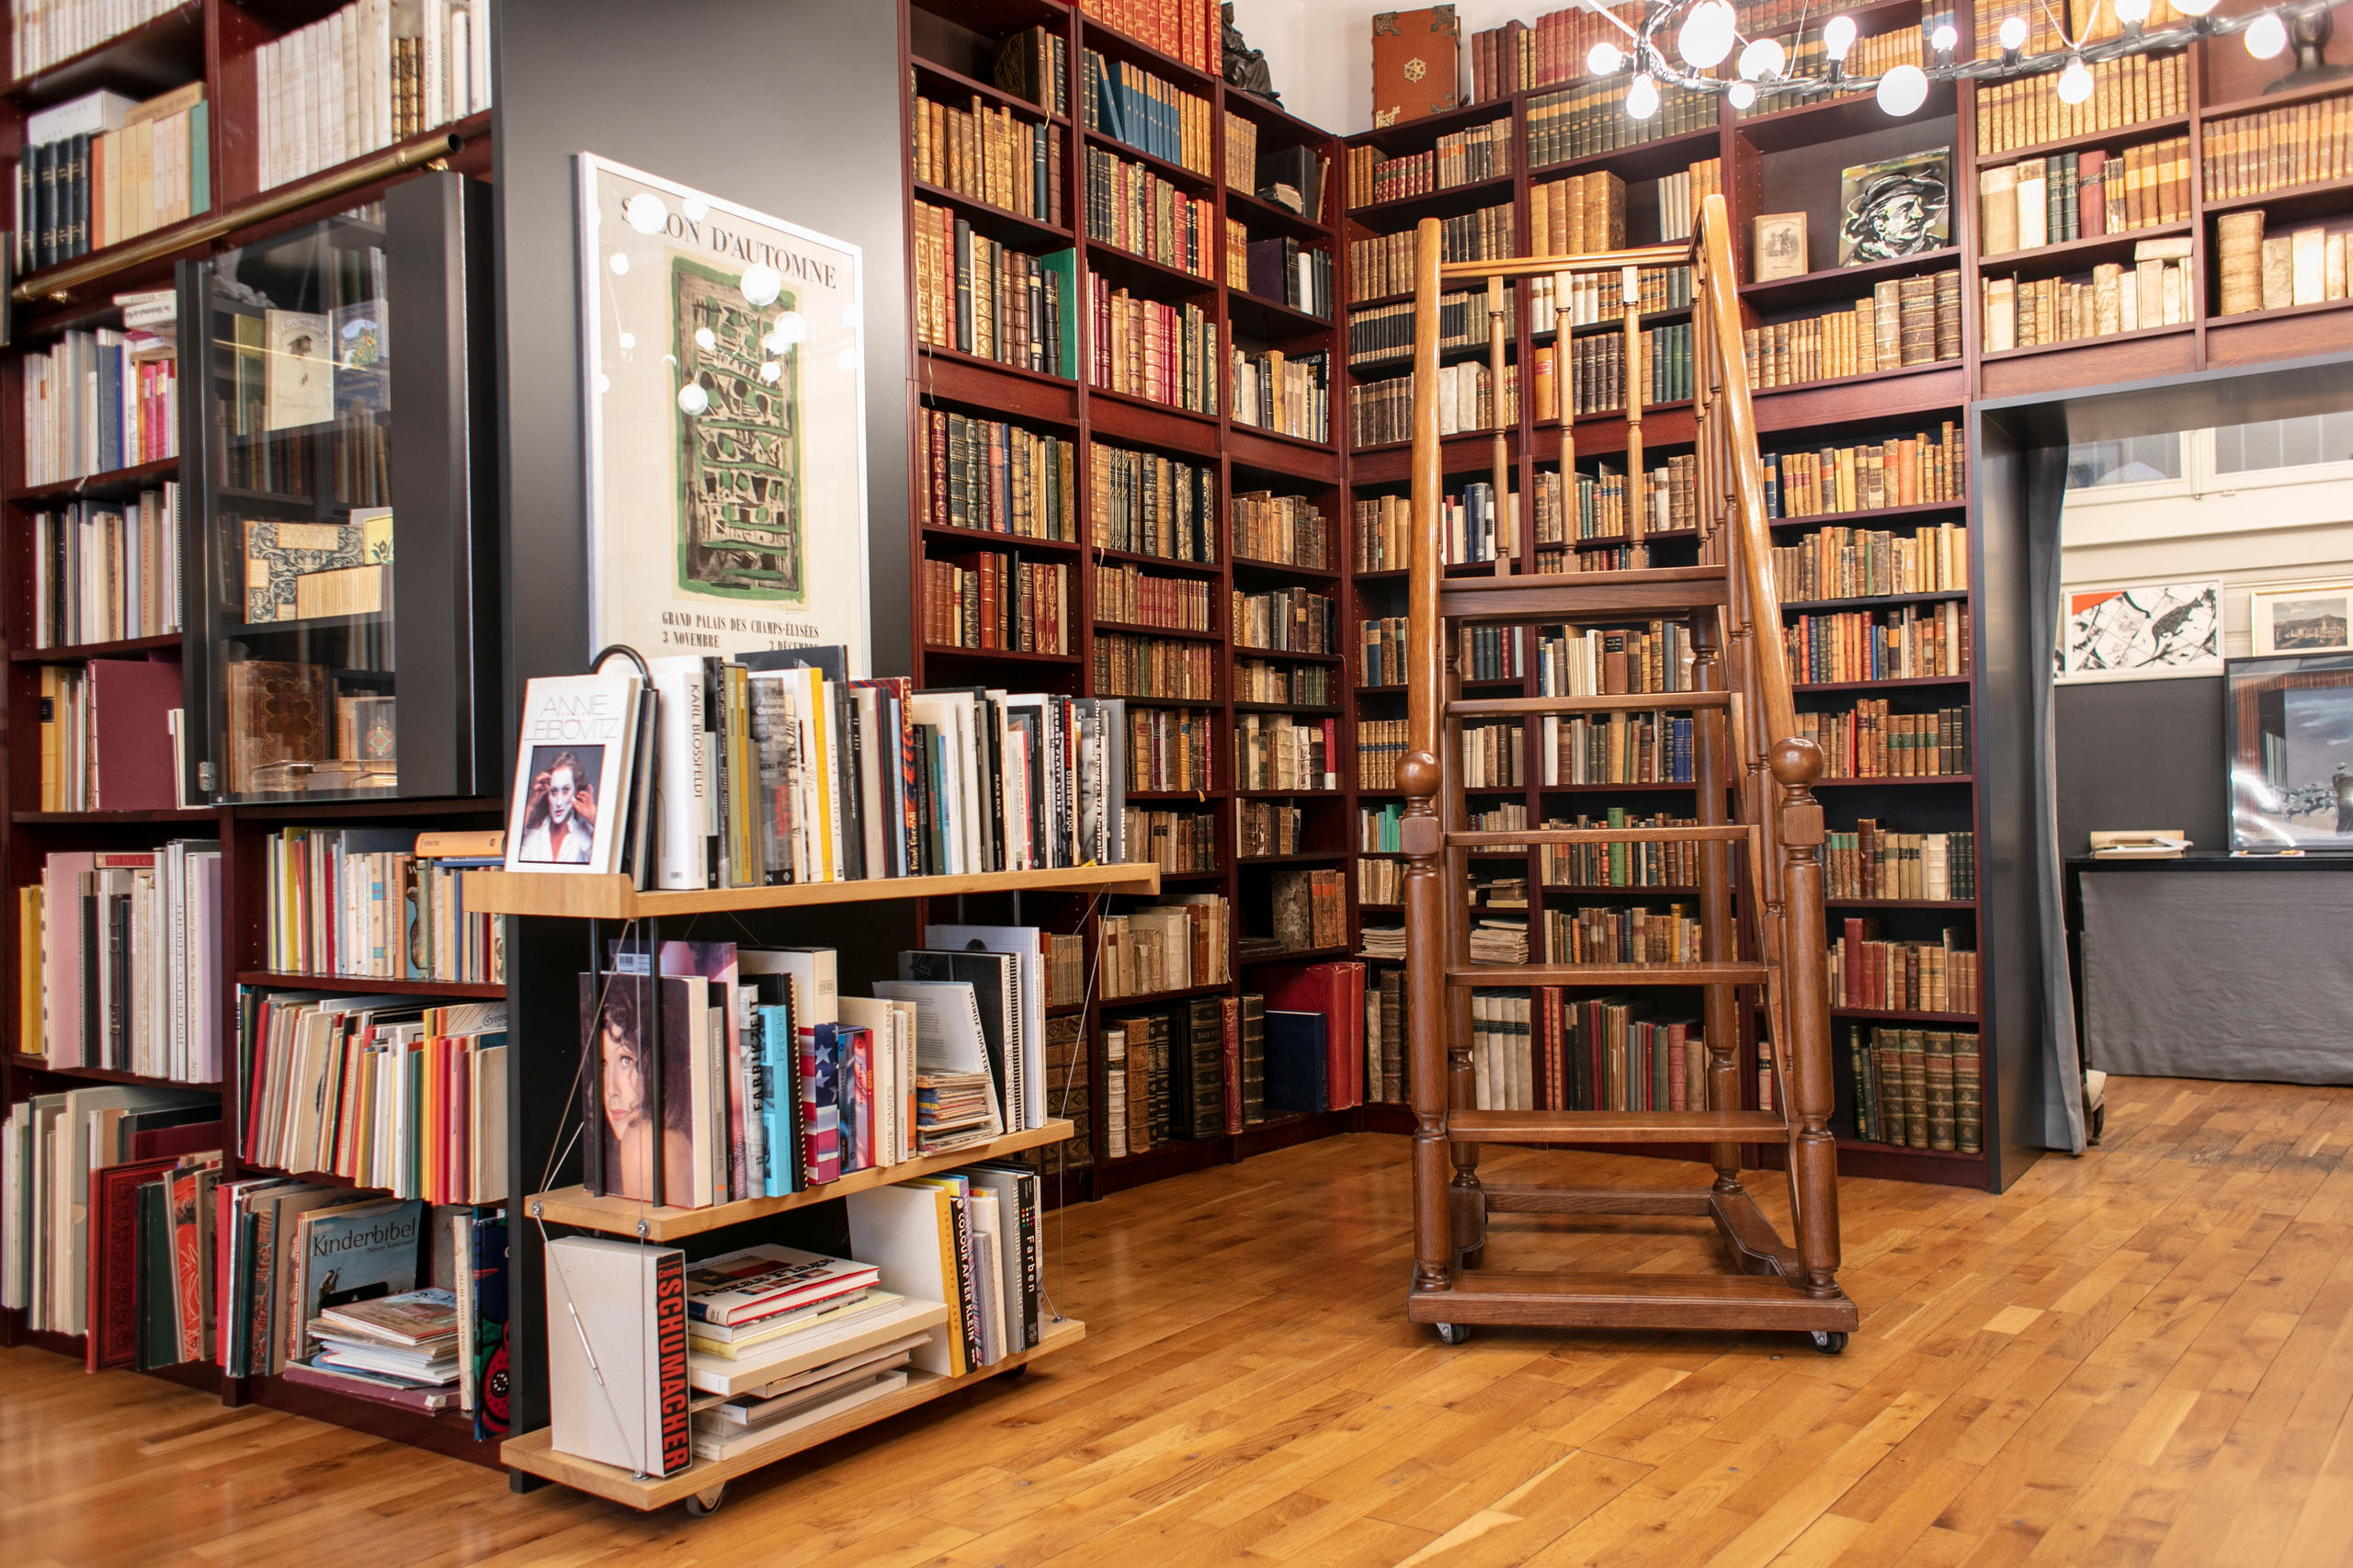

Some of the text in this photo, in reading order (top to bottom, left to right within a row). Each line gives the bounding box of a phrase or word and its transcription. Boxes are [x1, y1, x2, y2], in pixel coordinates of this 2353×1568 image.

[621, 197, 700, 245] SON
[662, 611, 820, 640] GRAND PALAIS DES CHAMPS-ÉLYSÉES
[662, 631, 721, 649] 3 NOVEMBRE
[690, 684, 705, 799] KARL BLOSSFELDT
[1094, 699, 1102, 746] Christian
[968, 990, 981, 1028] ZÜRICH
[776, 1012, 787, 1062] Einblicke
[886, 1085, 894, 1126] CYMATICS
[313, 1217, 416, 1257] Kinderbibel
[689, 1257, 836, 1298] Texas Flags
[957, 1211, 976, 1342] COLOUR AFTER KLEIN
[1025, 1234, 1038, 1293] Farben
[658, 1277, 688, 1471] SCHUMACHER
